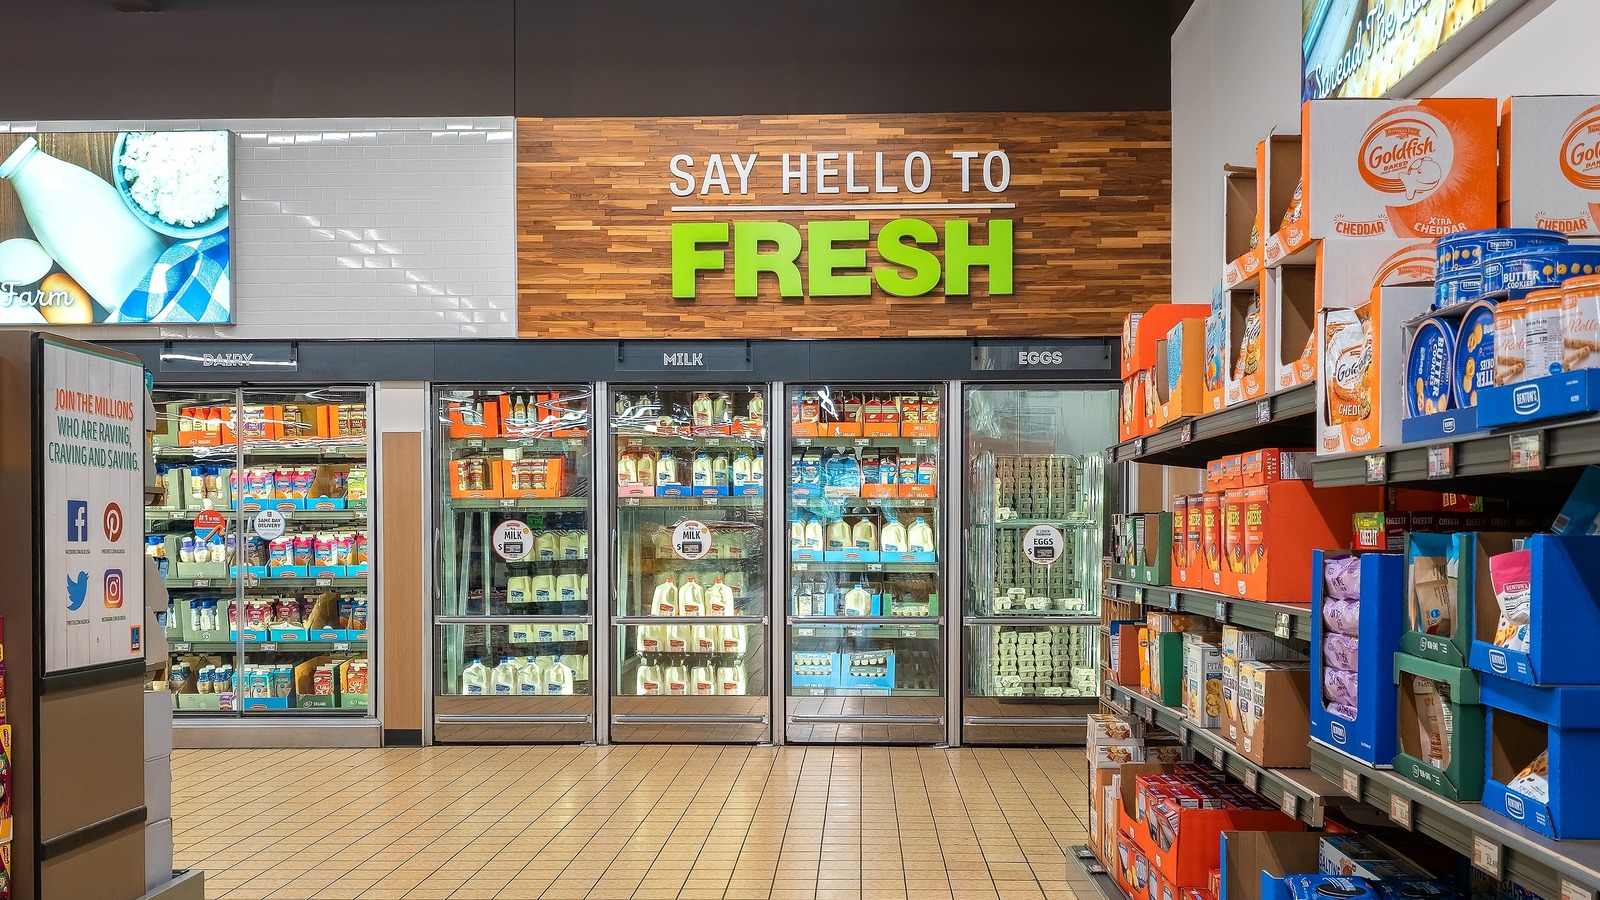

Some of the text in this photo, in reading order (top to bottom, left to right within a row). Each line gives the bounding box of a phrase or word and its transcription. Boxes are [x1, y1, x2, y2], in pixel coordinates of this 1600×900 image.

[1313, 20, 1362, 99] Spread
[1366, 3, 1396, 57] The
[1383, 160, 1409, 171] BAKED
[669, 149, 1010, 197] SAY HELLO TO
[1335, 221, 1385, 235] CHEDDAR
[1413, 222, 1468, 236] CHEDDAR
[1537, 218, 1588, 233] CHEDDAR
[1489, 240, 1514, 249] BENTON'S
[671, 218, 1013, 299] FRESH
[1503, 271, 1540, 284] BUTTER
[1507, 280, 1534, 289] COOKIES
[1, 280, 74, 307] Farm
[203, 353, 253, 367] DAIRY
[663, 351, 703, 366] MILK
[1019, 350, 1063, 365] EGGS
[1429, 344, 1438, 386] COOKIES
[1432, 336, 1444, 397] BUTTER
[55, 388, 134, 422] JOIN THE MILLIONS
[1516, 390, 1537, 406] BENTON'S
[57, 415, 132, 449] WHO ARE RAVING,
[48, 442, 140, 472] CRAVING AND SAVING.
[1247, 510, 1262, 526] CHEESE
[504, 531, 522, 540] MILK
[682, 531, 701, 540] MILK
[1033, 538, 1054, 546] EGGS
[498, 543, 503, 551] $
[676, 543, 682, 551] $
[1027, 547, 1032, 555] $
[1505, 583, 1529, 591] BENTON'S
[1206, 662, 1222, 670] PITA
